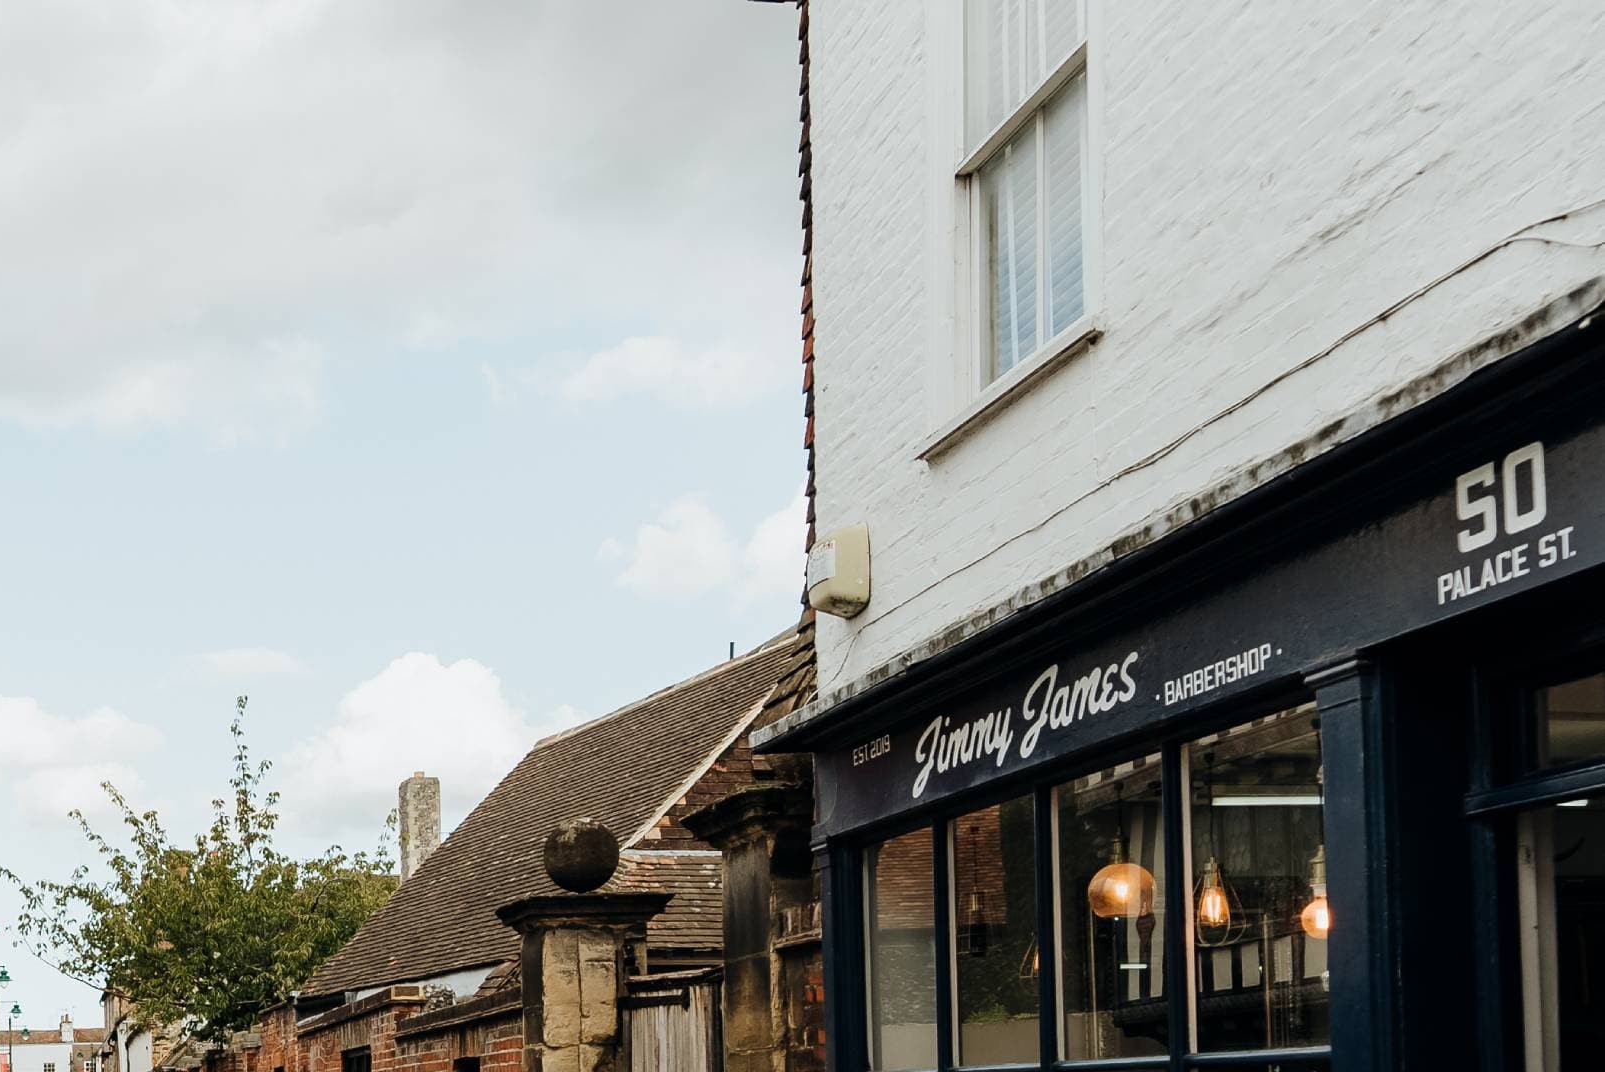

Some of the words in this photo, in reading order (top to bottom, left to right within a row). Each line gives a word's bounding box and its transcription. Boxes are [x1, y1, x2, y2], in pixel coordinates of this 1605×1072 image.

[1456, 441, 1547, 553] 50
[1437, 543, 1530, 605] PALACE
[1538, 526, 1577, 568] ST.
[1164, 643, 1271, 706] BARBERSHOP
[912, 707, 1013, 799] Jimmy
[1020, 651, 1139, 759] James
